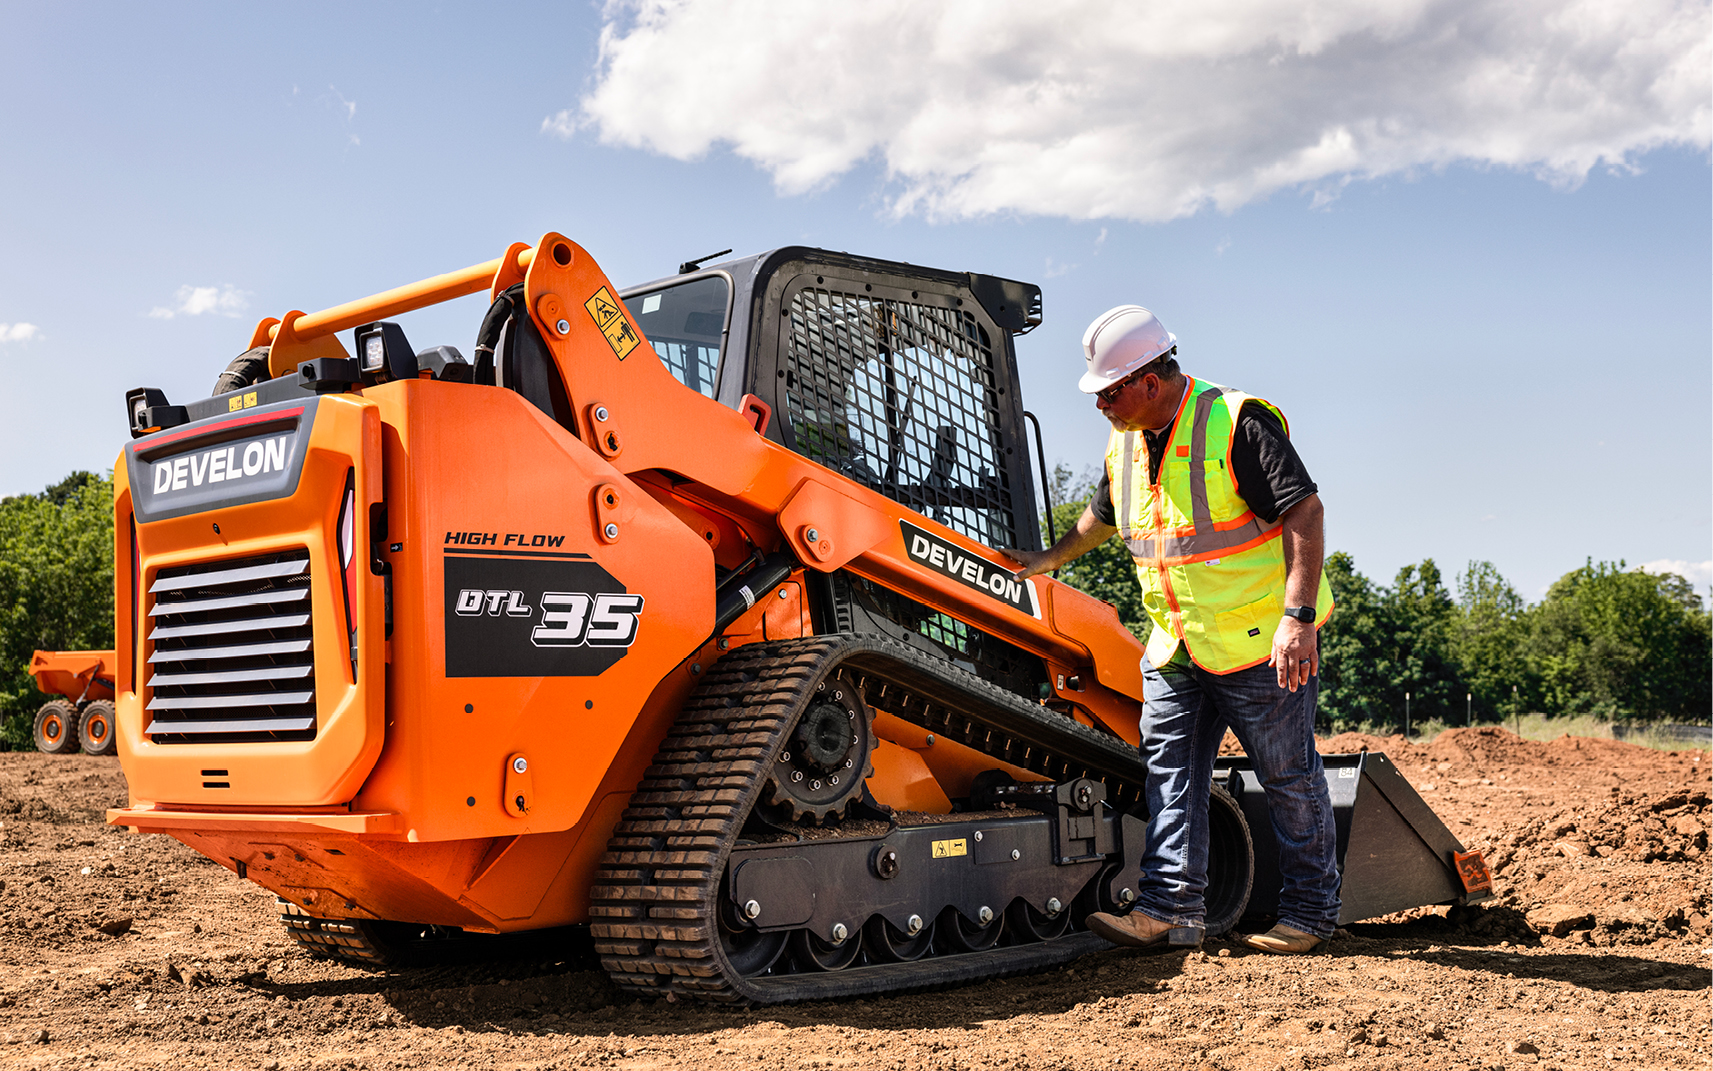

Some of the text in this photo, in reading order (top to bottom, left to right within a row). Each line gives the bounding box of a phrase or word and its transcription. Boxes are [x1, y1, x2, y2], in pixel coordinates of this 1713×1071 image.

[153, 437, 286, 495] DEVELON
[444, 532, 565, 547] HIGH FLOW
[911, 534, 1022, 603] DEVELON
[455, 589, 645, 648] DTL 35
